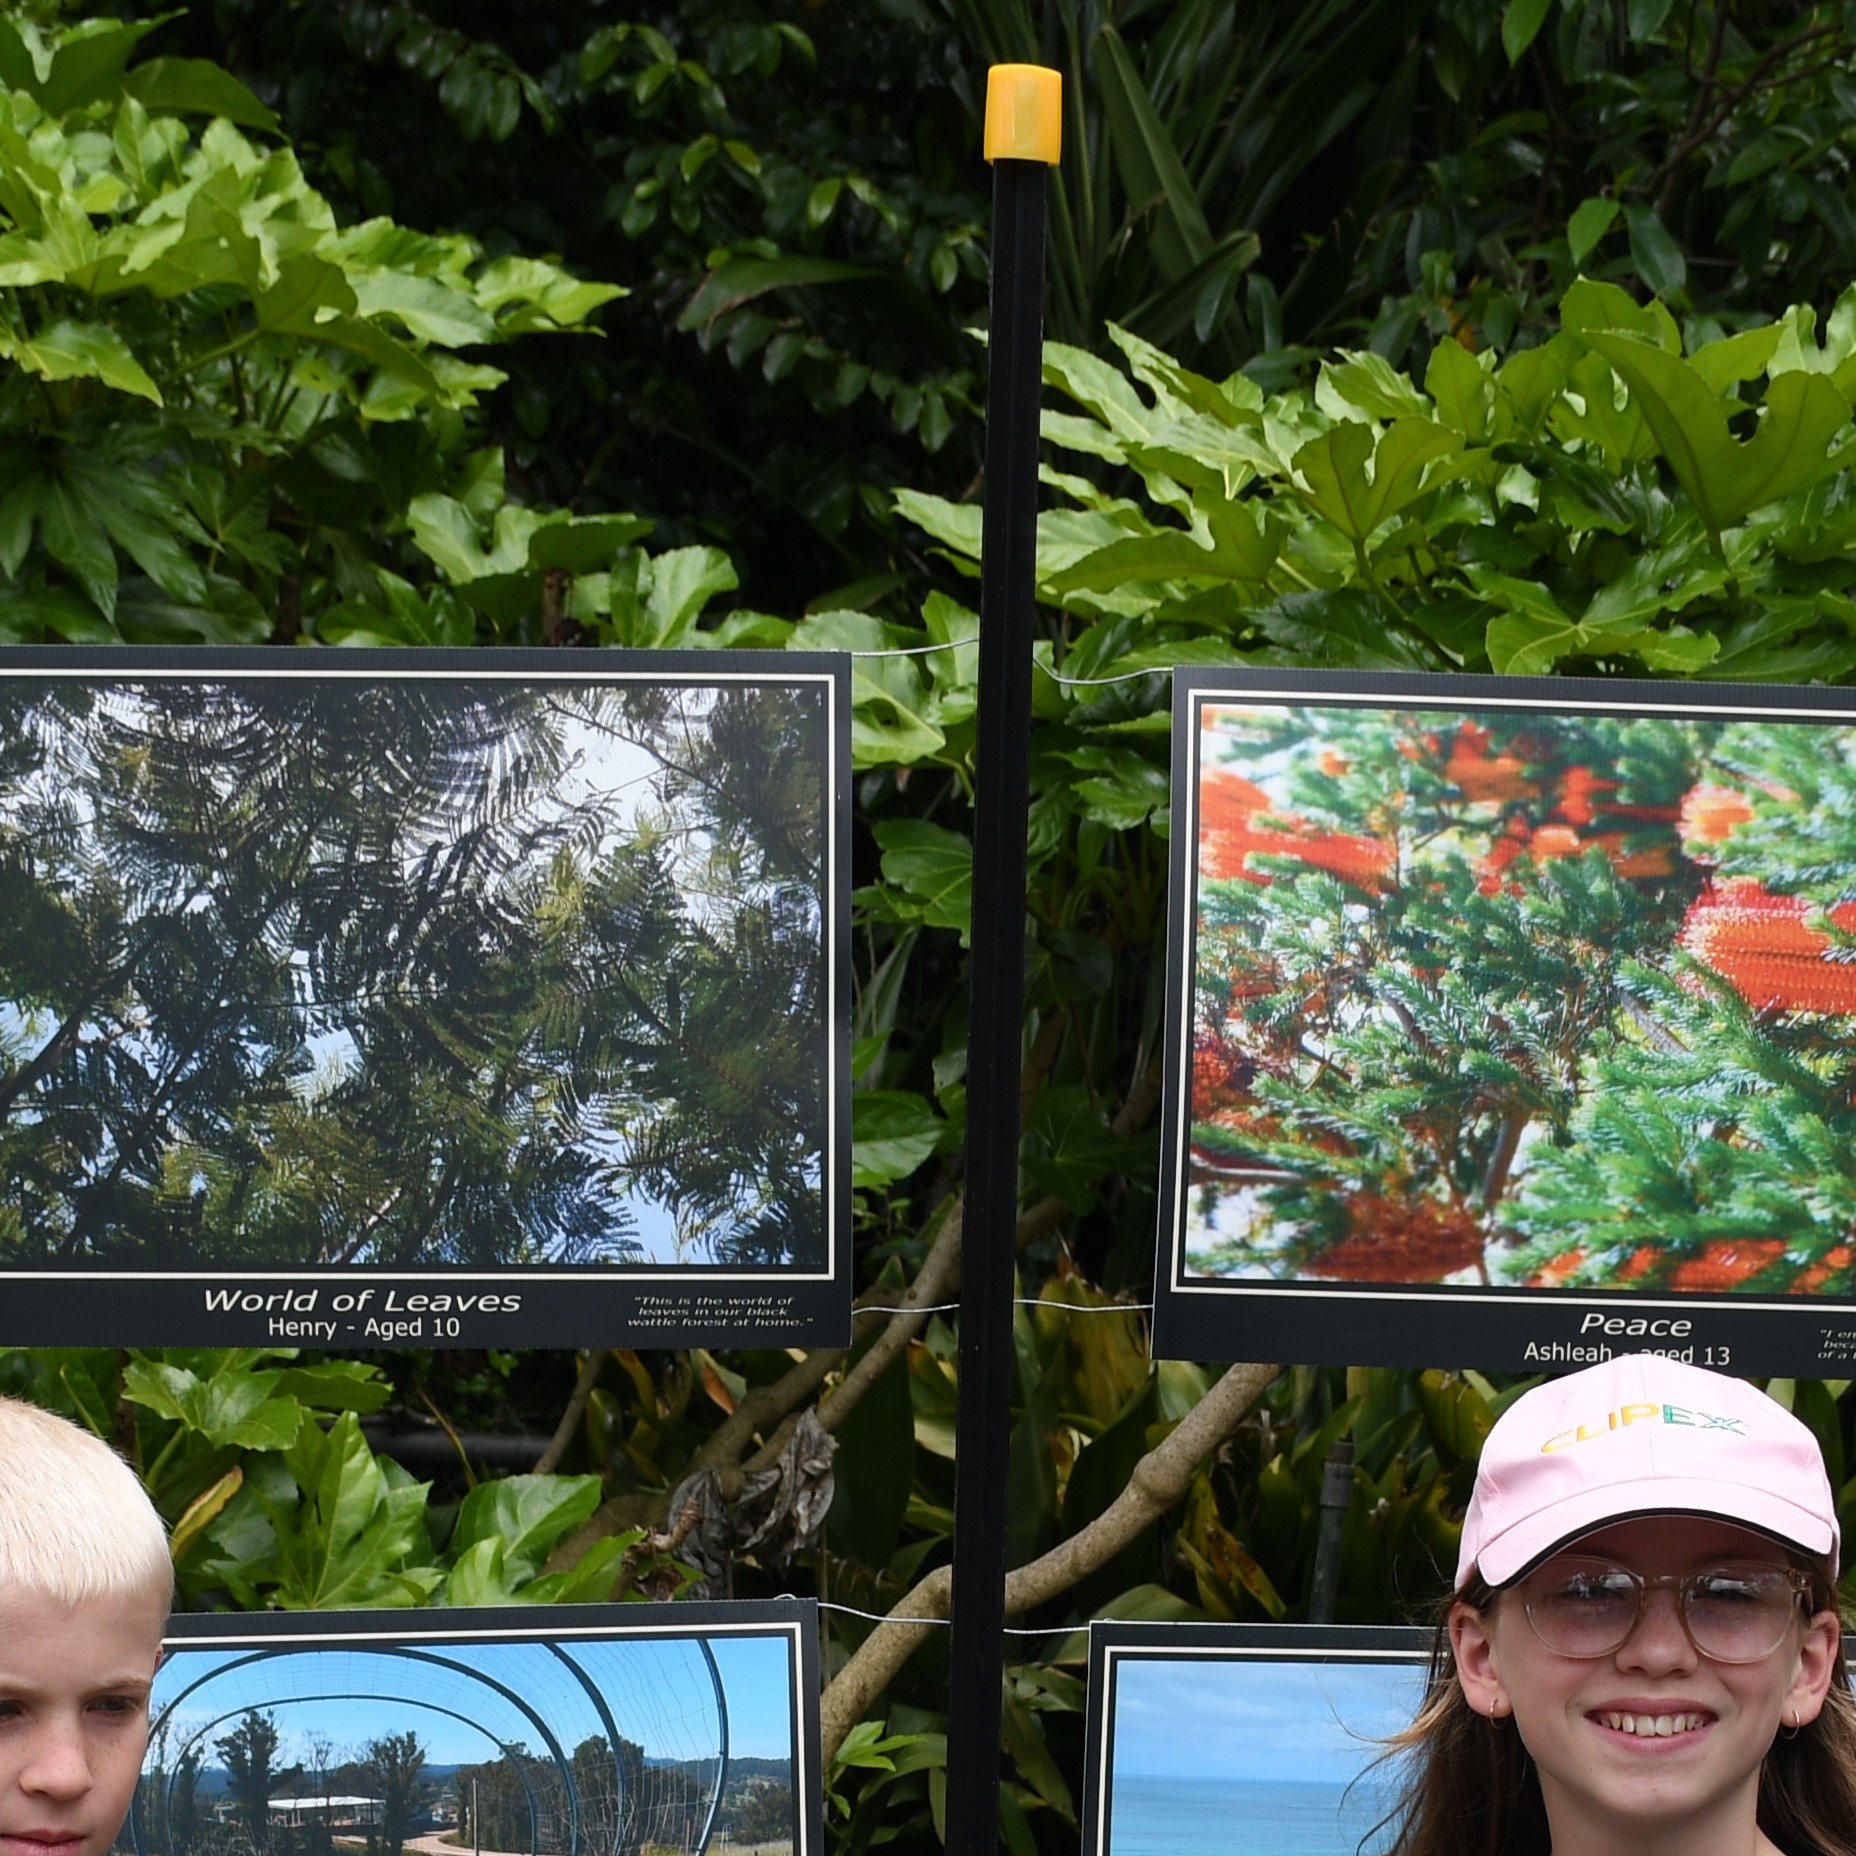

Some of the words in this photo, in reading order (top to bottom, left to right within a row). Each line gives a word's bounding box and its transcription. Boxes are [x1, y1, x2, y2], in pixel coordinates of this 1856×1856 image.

[204, 1289, 319, 1312] World
[332, 1289, 376, 1312] of
[384, 1290, 522, 1312] Leaves
[638, 1307, 690, 1316] leaves
[694, 1307, 709, 1316] in
[714, 1308, 742, 1316] our
[746, 1307, 789, 1316] black
[678, 1296, 691, 1306] is
[696, 1296, 723, 1306] the
[728, 1296, 772, 1306] world
[777, 1296, 795, 1306] of
[268, 1317, 337, 1341] Henry
[364, 1317, 422, 1341] Aged
[433, 1317, 460, 1337] 10
[627, 1317, 677, 1327] wattle
[681, 1317, 728, 1327] forest
[733, 1317, 749, 1327] at
[1580, 1313, 1692, 1337] Peace
[1523, 1341, 1612, 1362] Ashleah
[1704, 1346, 1730, 1366] 13
[1817, 1350, 1835, 1359] of
[1541, 1403, 1750, 1454] CLIPEX
